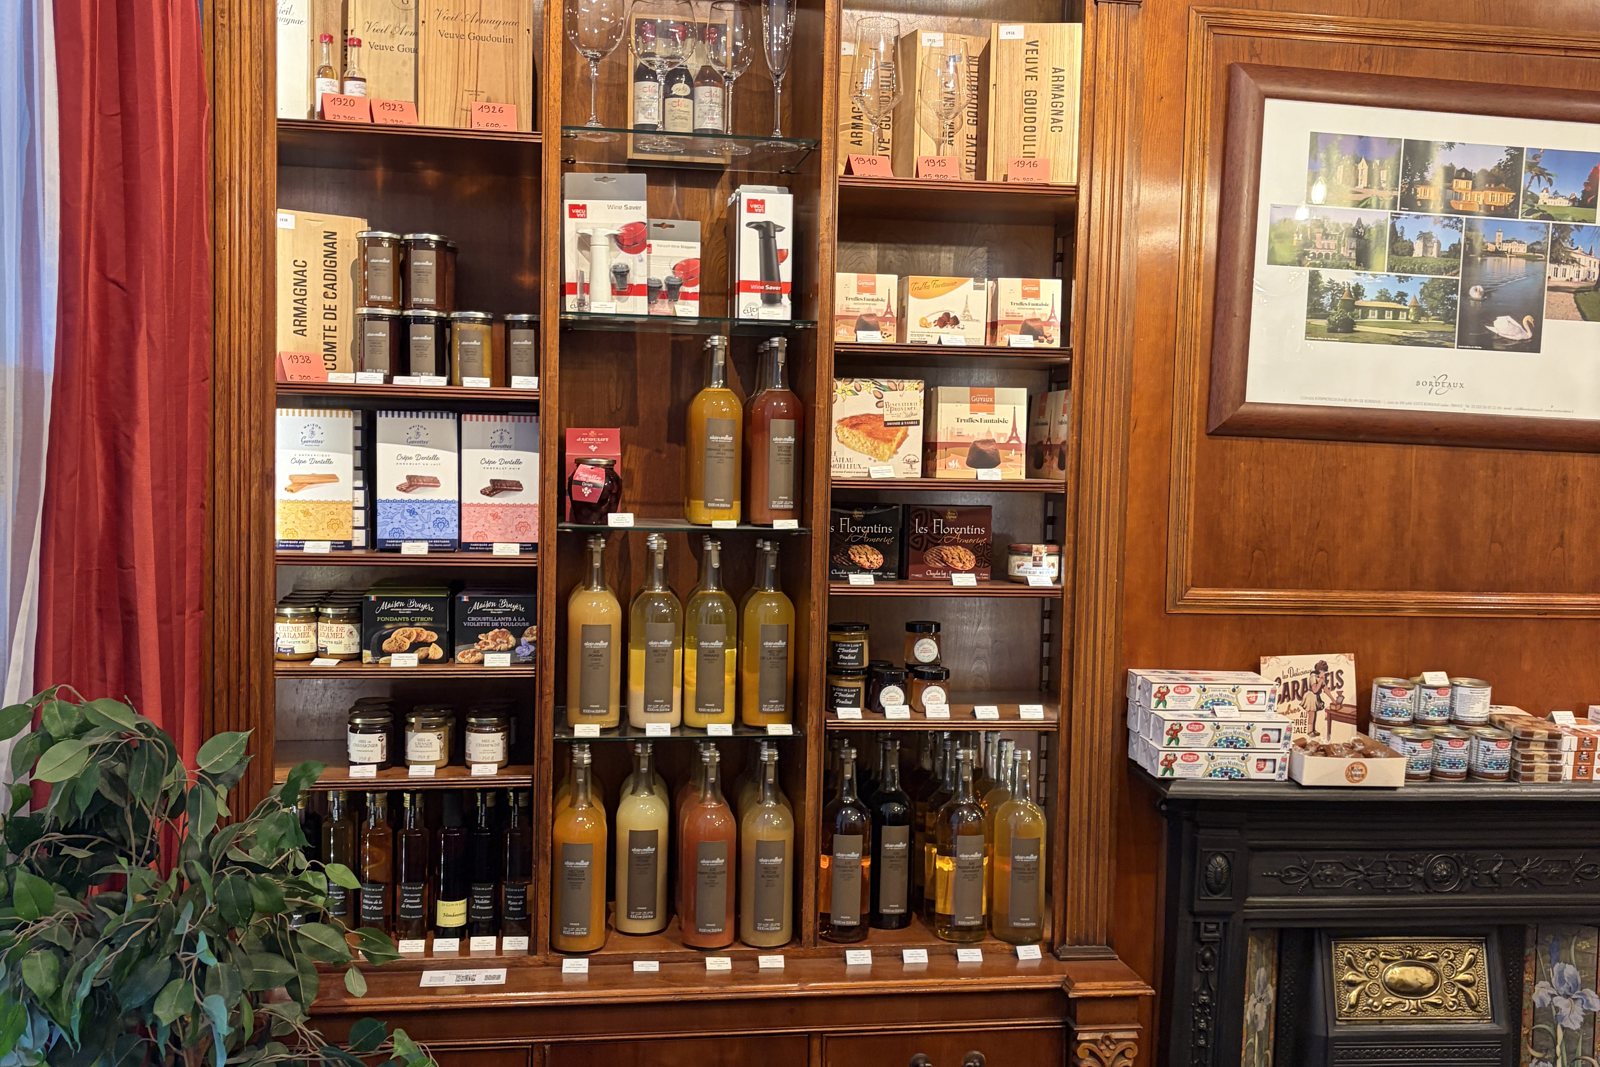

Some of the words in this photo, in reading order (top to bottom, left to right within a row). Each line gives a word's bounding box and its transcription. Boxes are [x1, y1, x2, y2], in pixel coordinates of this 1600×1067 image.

[437, 29, 465, 41] Veuve
[467, 31, 515, 44] Goudoulin
[367, 40, 395, 54] Veuve
[1024, 39, 1040, 82] VEUVE
[330, 97, 356, 107] 1920
[1050, 67, 1066, 134] ARMAGNAC
[379, 102, 405, 112] 1923
[477, 104, 505, 114] 1926
[854, 157, 878, 166] 1910
[924, 158, 947, 168] 1915
[1014, 160, 1038, 169] 1916
[323, 231, 337, 300] CADIGNAN
[293, 259, 308, 338] ARMAGNAC
[323, 303, 337, 322] DE
[323, 325, 337, 371] COMTE
[288, 354, 312, 364] 1938
[1415, 379, 1465, 389] BORDEAUX
[308, 457, 334, 465] Dentelle
[415, 453, 441, 461] Dentelle
[839, 517, 893, 534] Florentins
[915, 518, 929, 534] les
[933, 518, 985, 535] Florentins
